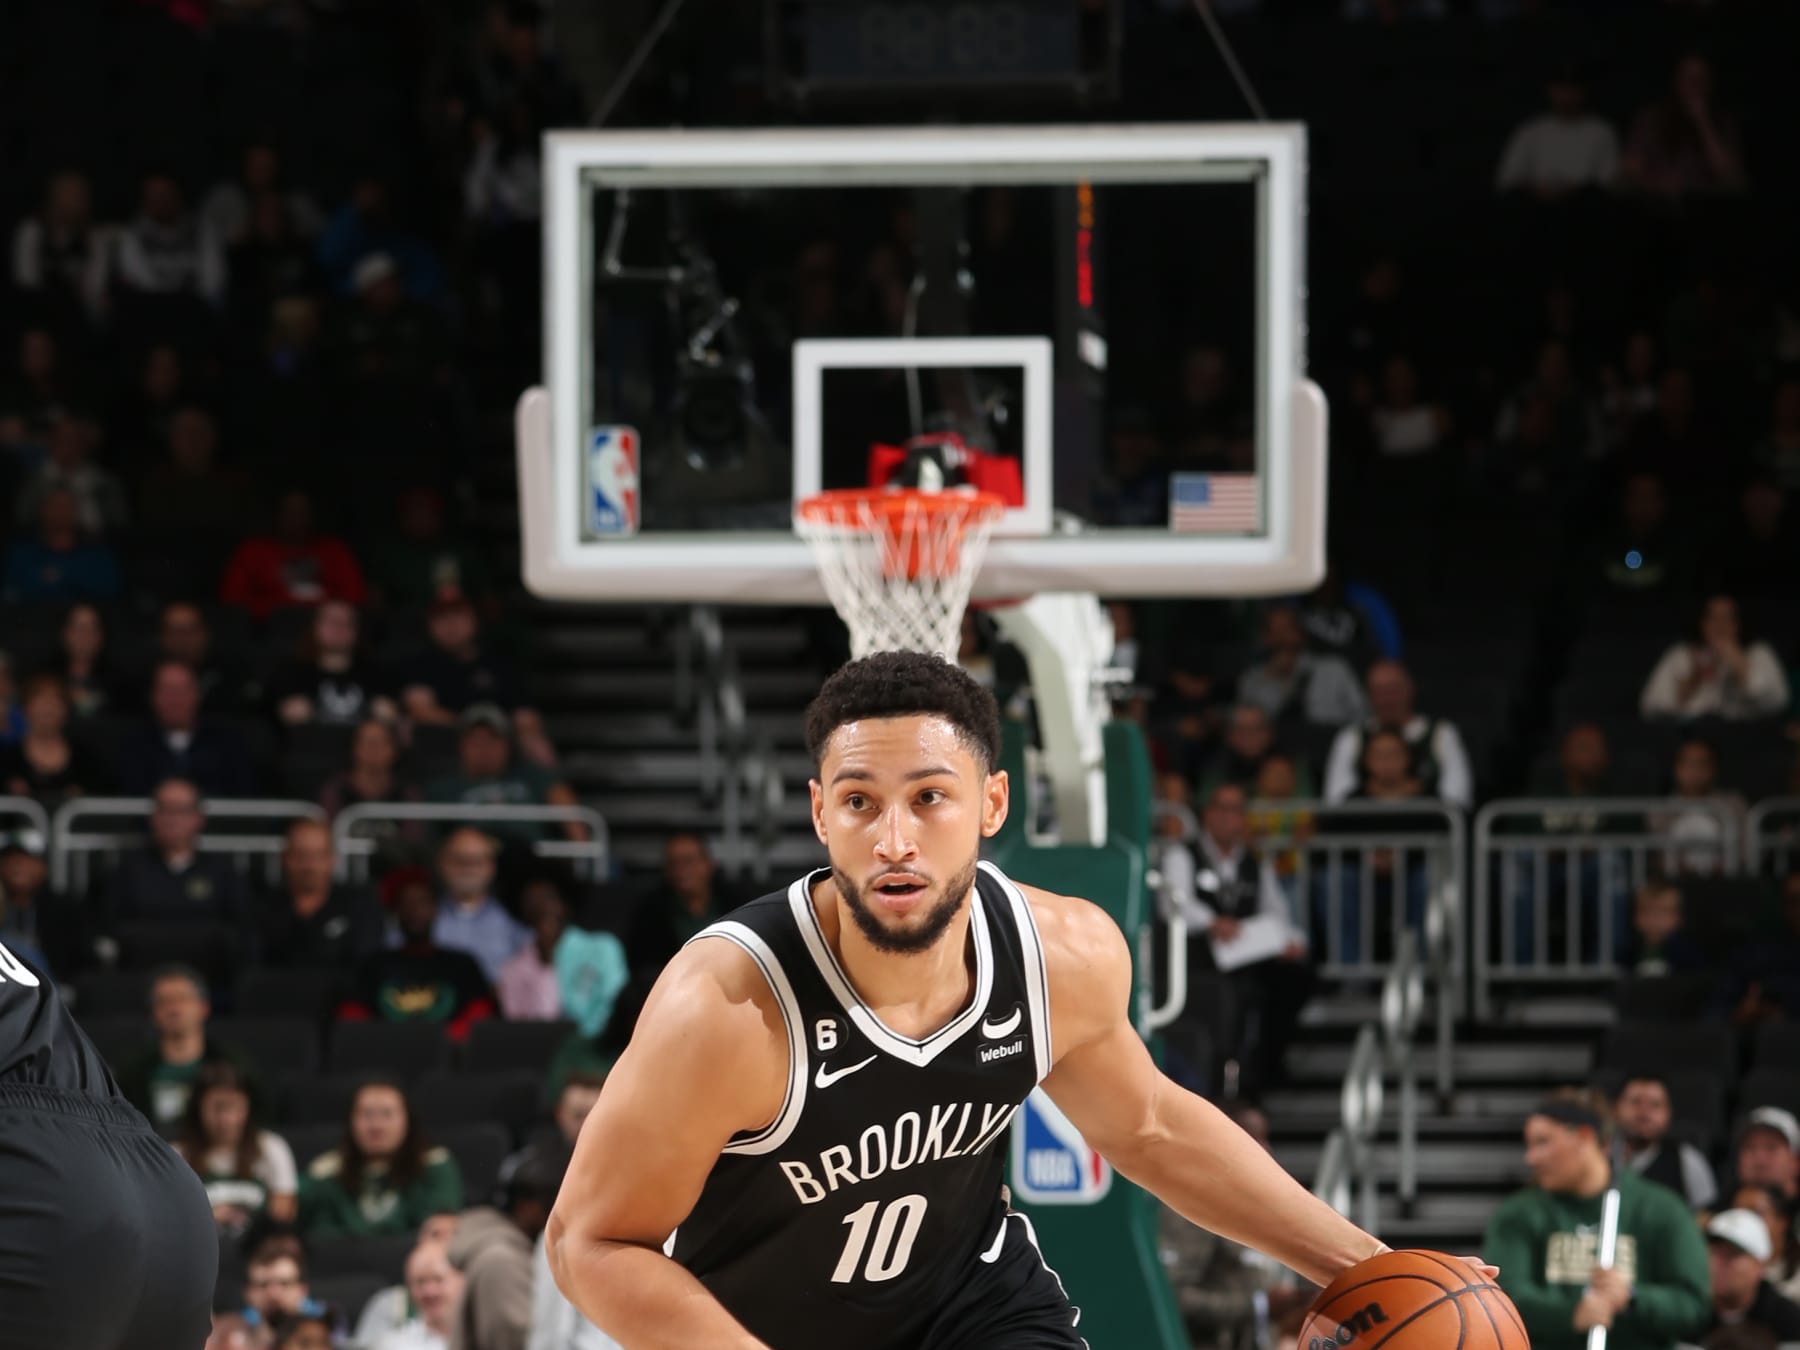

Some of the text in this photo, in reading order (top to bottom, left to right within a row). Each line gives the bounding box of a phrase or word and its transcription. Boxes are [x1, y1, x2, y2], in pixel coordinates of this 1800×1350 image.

[816, 1019, 838, 1051] 6
[981, 1040, 1023, 1063] Webull
[831, 1194, 928, 1284] 10
